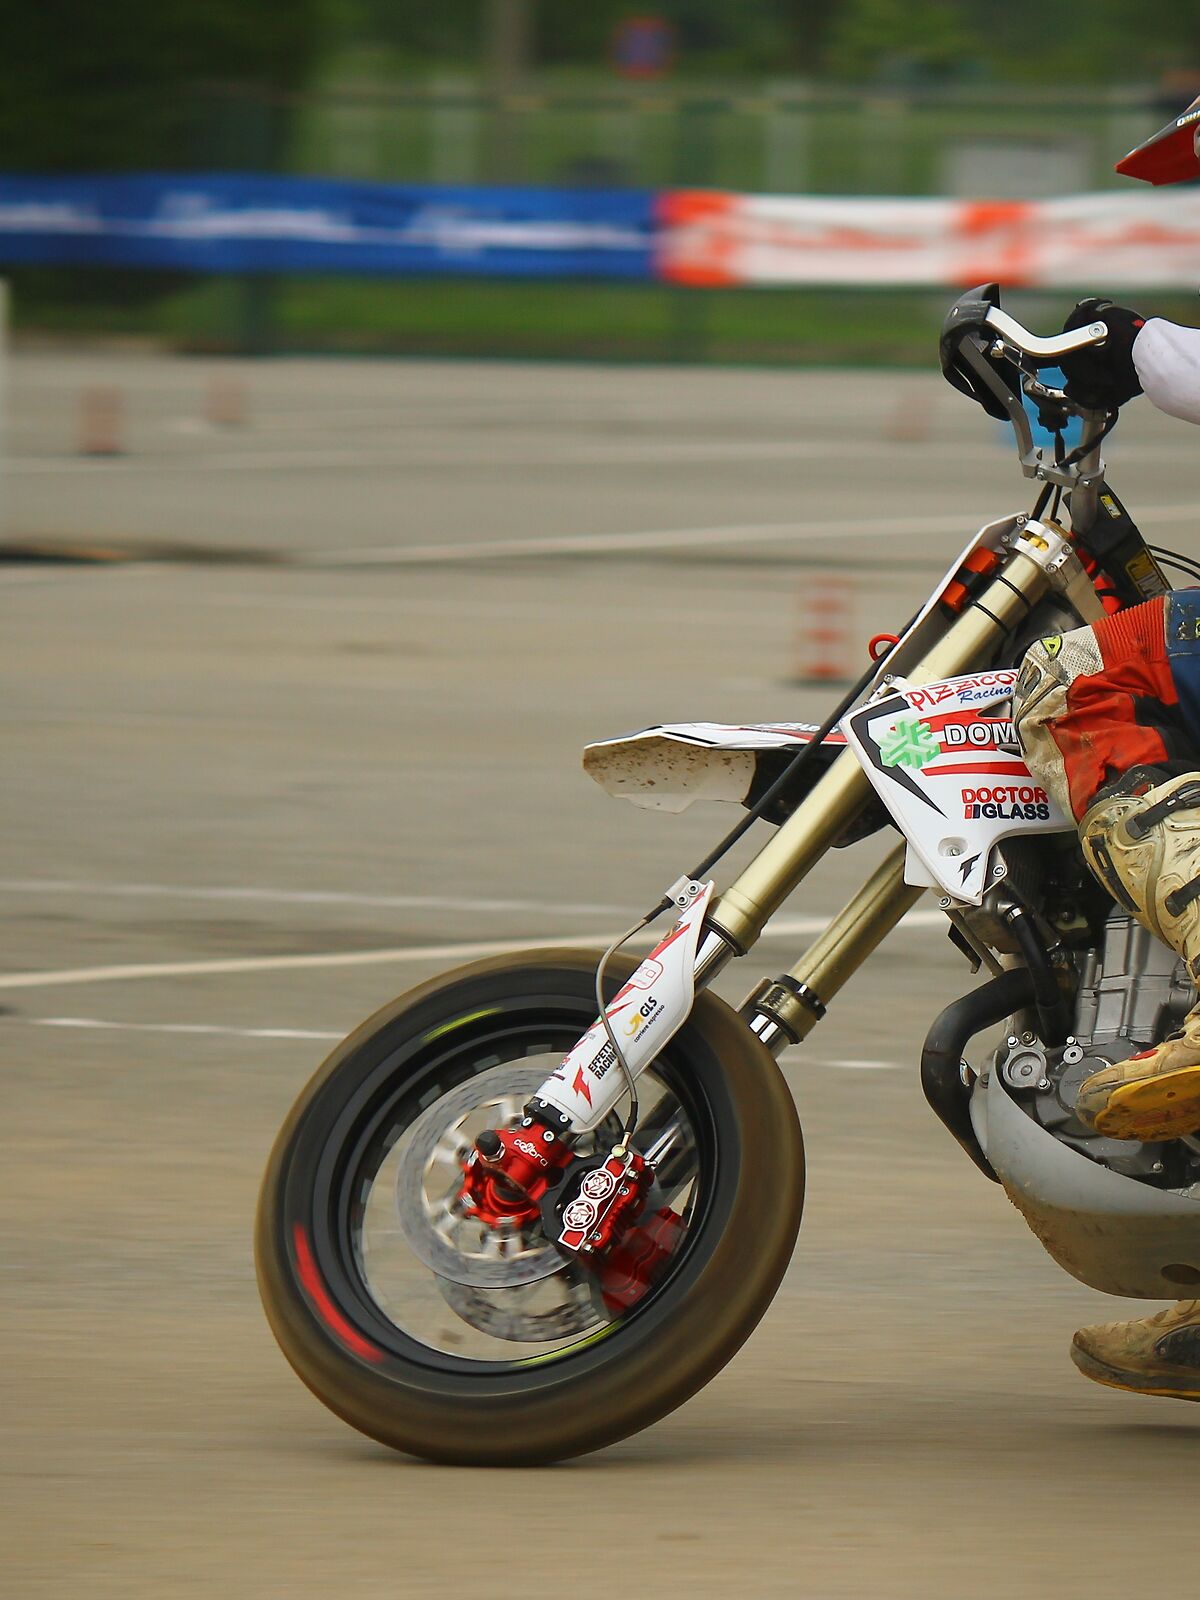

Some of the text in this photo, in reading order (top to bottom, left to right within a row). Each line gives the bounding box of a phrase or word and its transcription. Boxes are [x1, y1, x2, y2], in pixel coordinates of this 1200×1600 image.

[905, 671, 1020, 712] PIZZICO
[957, 686, 1014, 704] Racing
[943, 720, 1020, 747] DOM
[961, 786, 1049, 804] DOCTOR
[982, 803, 1050, 820] GLASS
[639, 996, 658, 1018] GLS
[587, 1039, 615, 1073] EFFETT
[594, 1049, 618, 1080] RACIN
